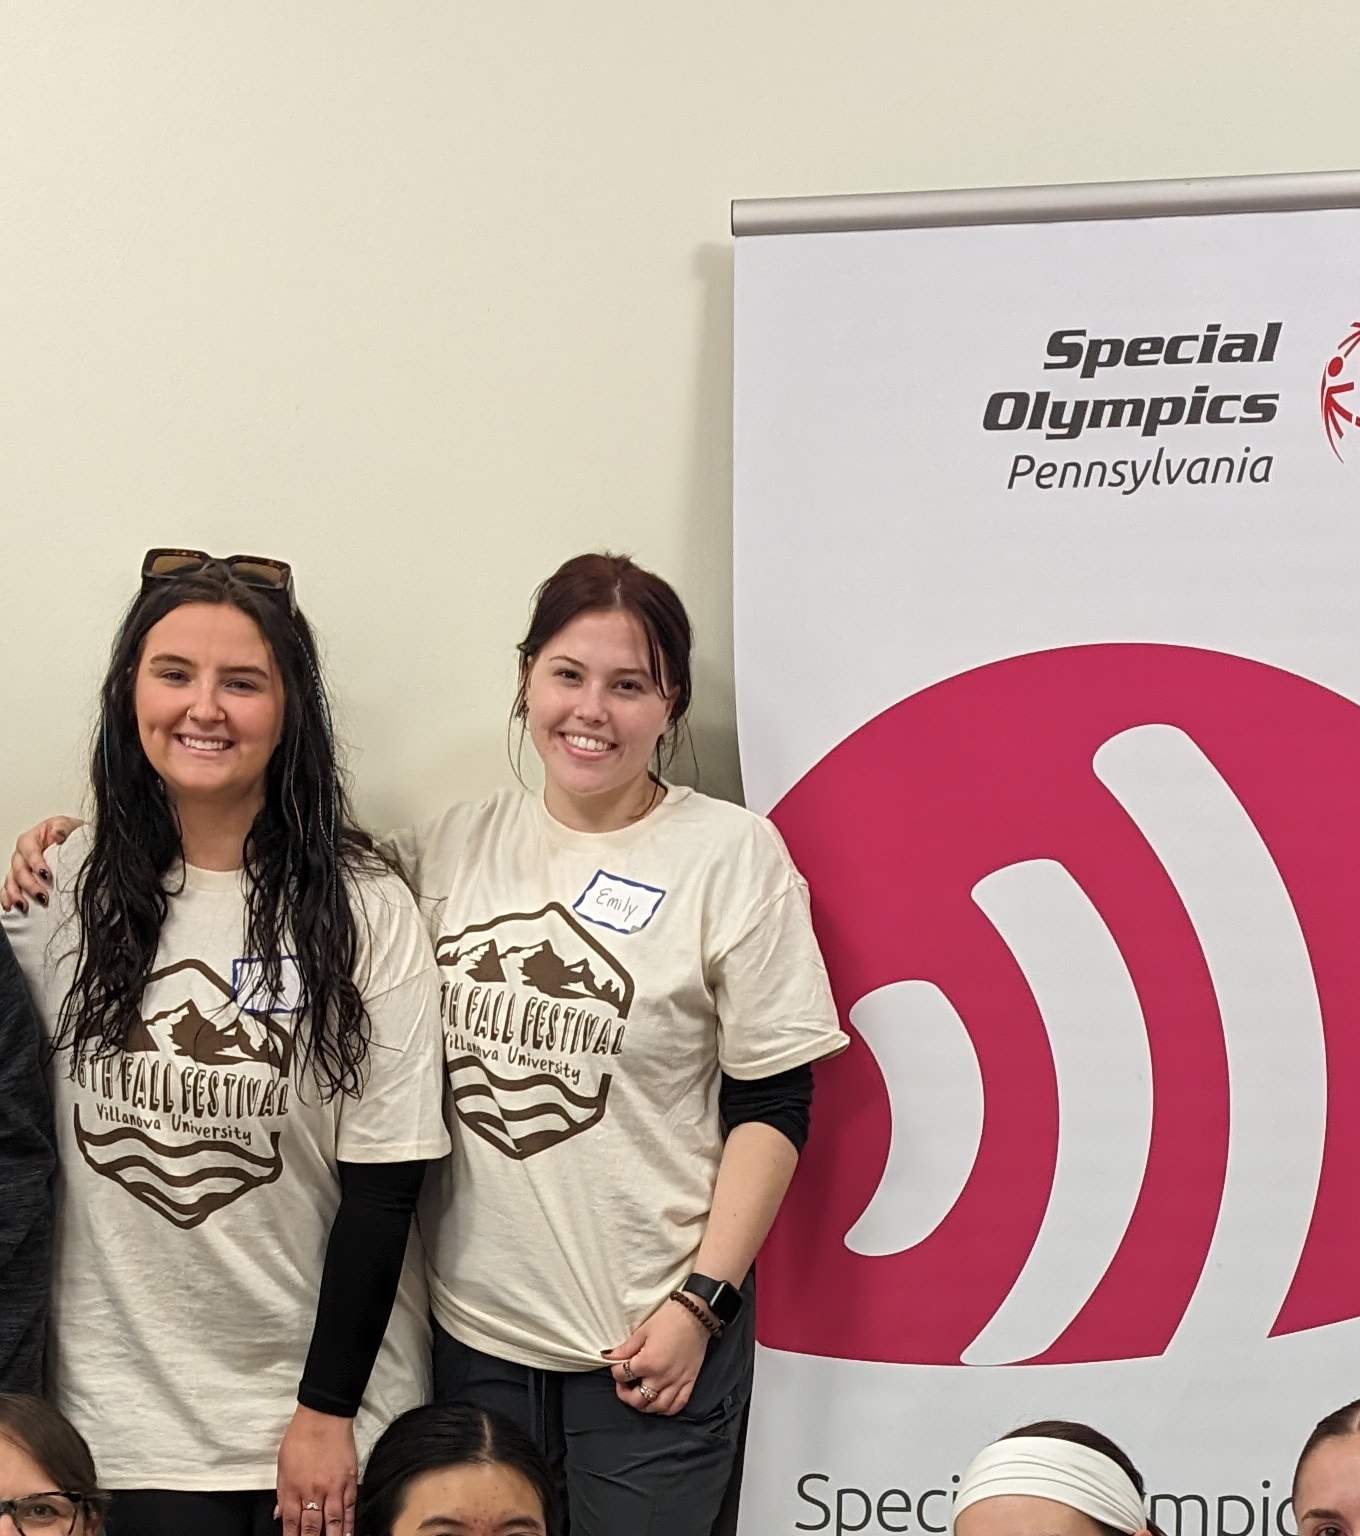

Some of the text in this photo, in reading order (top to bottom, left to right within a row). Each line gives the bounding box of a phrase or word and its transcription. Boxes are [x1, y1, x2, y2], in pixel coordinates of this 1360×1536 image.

[1043, 321, 1283, 379] Special
[982, 386, 1281, 441] Olympics
[1007, 446, 1275, 497] Pennsylvania
[596, 887, 641, 923] Emily
[465, 985, 517, 1045] FALL
[520, 996, 626, 1056] FESTIVAL
[121, 1055, 175, 1114] FALL
[180, 1066, 290, 1121] FESTIVAL
[507, 1045, 581, 1086] University
[96, 1102, 253, 1147] Villanova University
